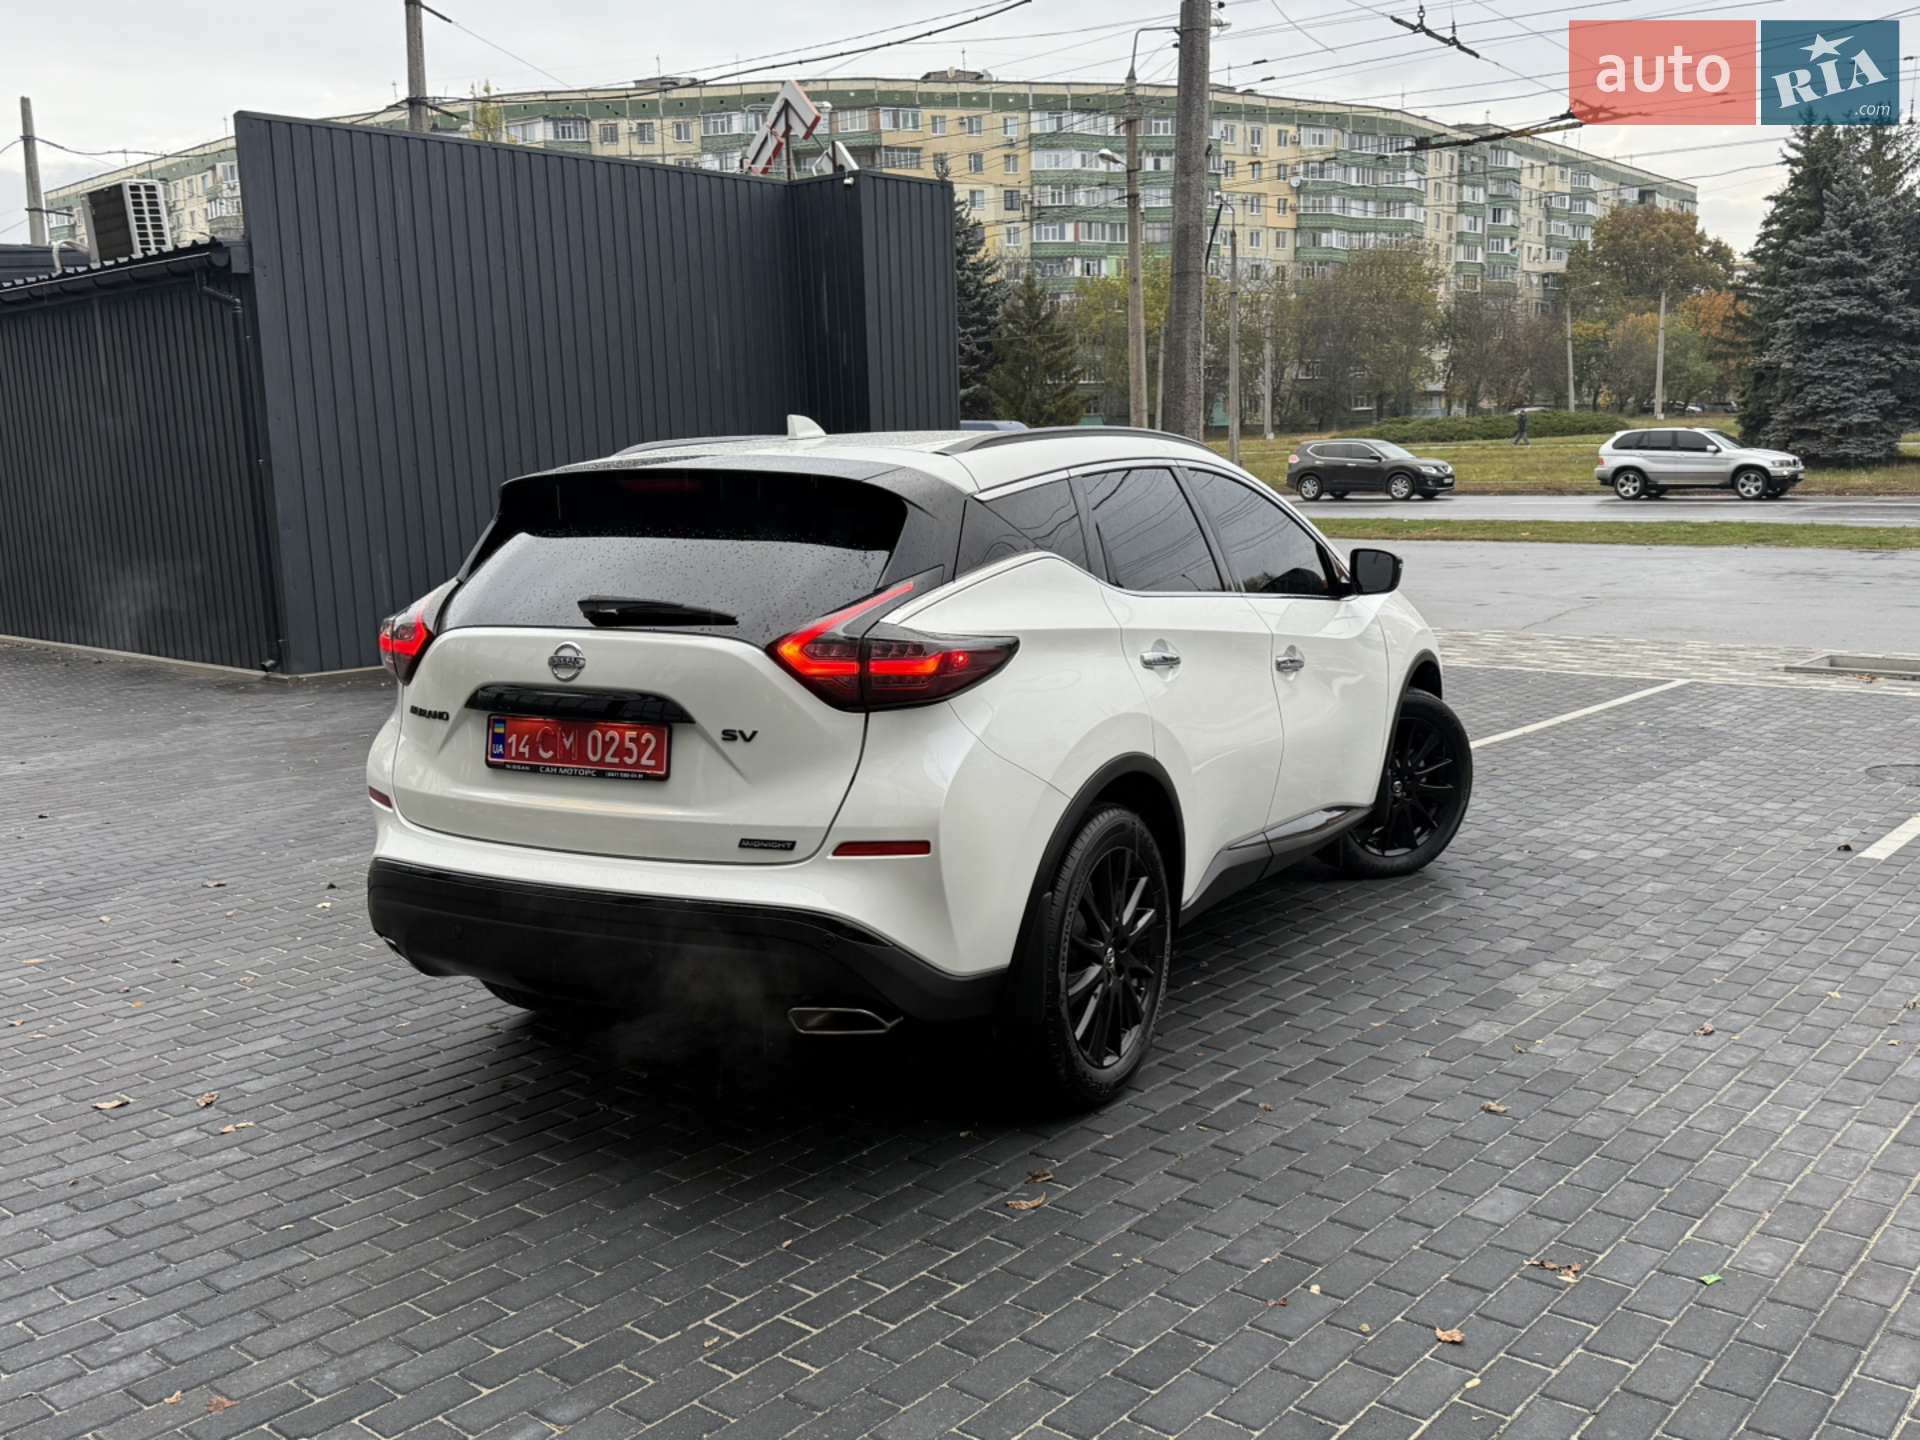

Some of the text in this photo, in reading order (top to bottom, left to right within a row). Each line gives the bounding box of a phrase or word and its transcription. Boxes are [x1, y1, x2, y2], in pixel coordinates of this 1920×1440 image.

[721, 729, 759, 743] SV
[492, 743, 504, 755] UA
[507, 734, 530, 759] 14
[587, 729, 657, 767] 0252
[539, 766, 597, 777] САН МОТОРС
[741, 839, 793, 849] MIDNIGHT
